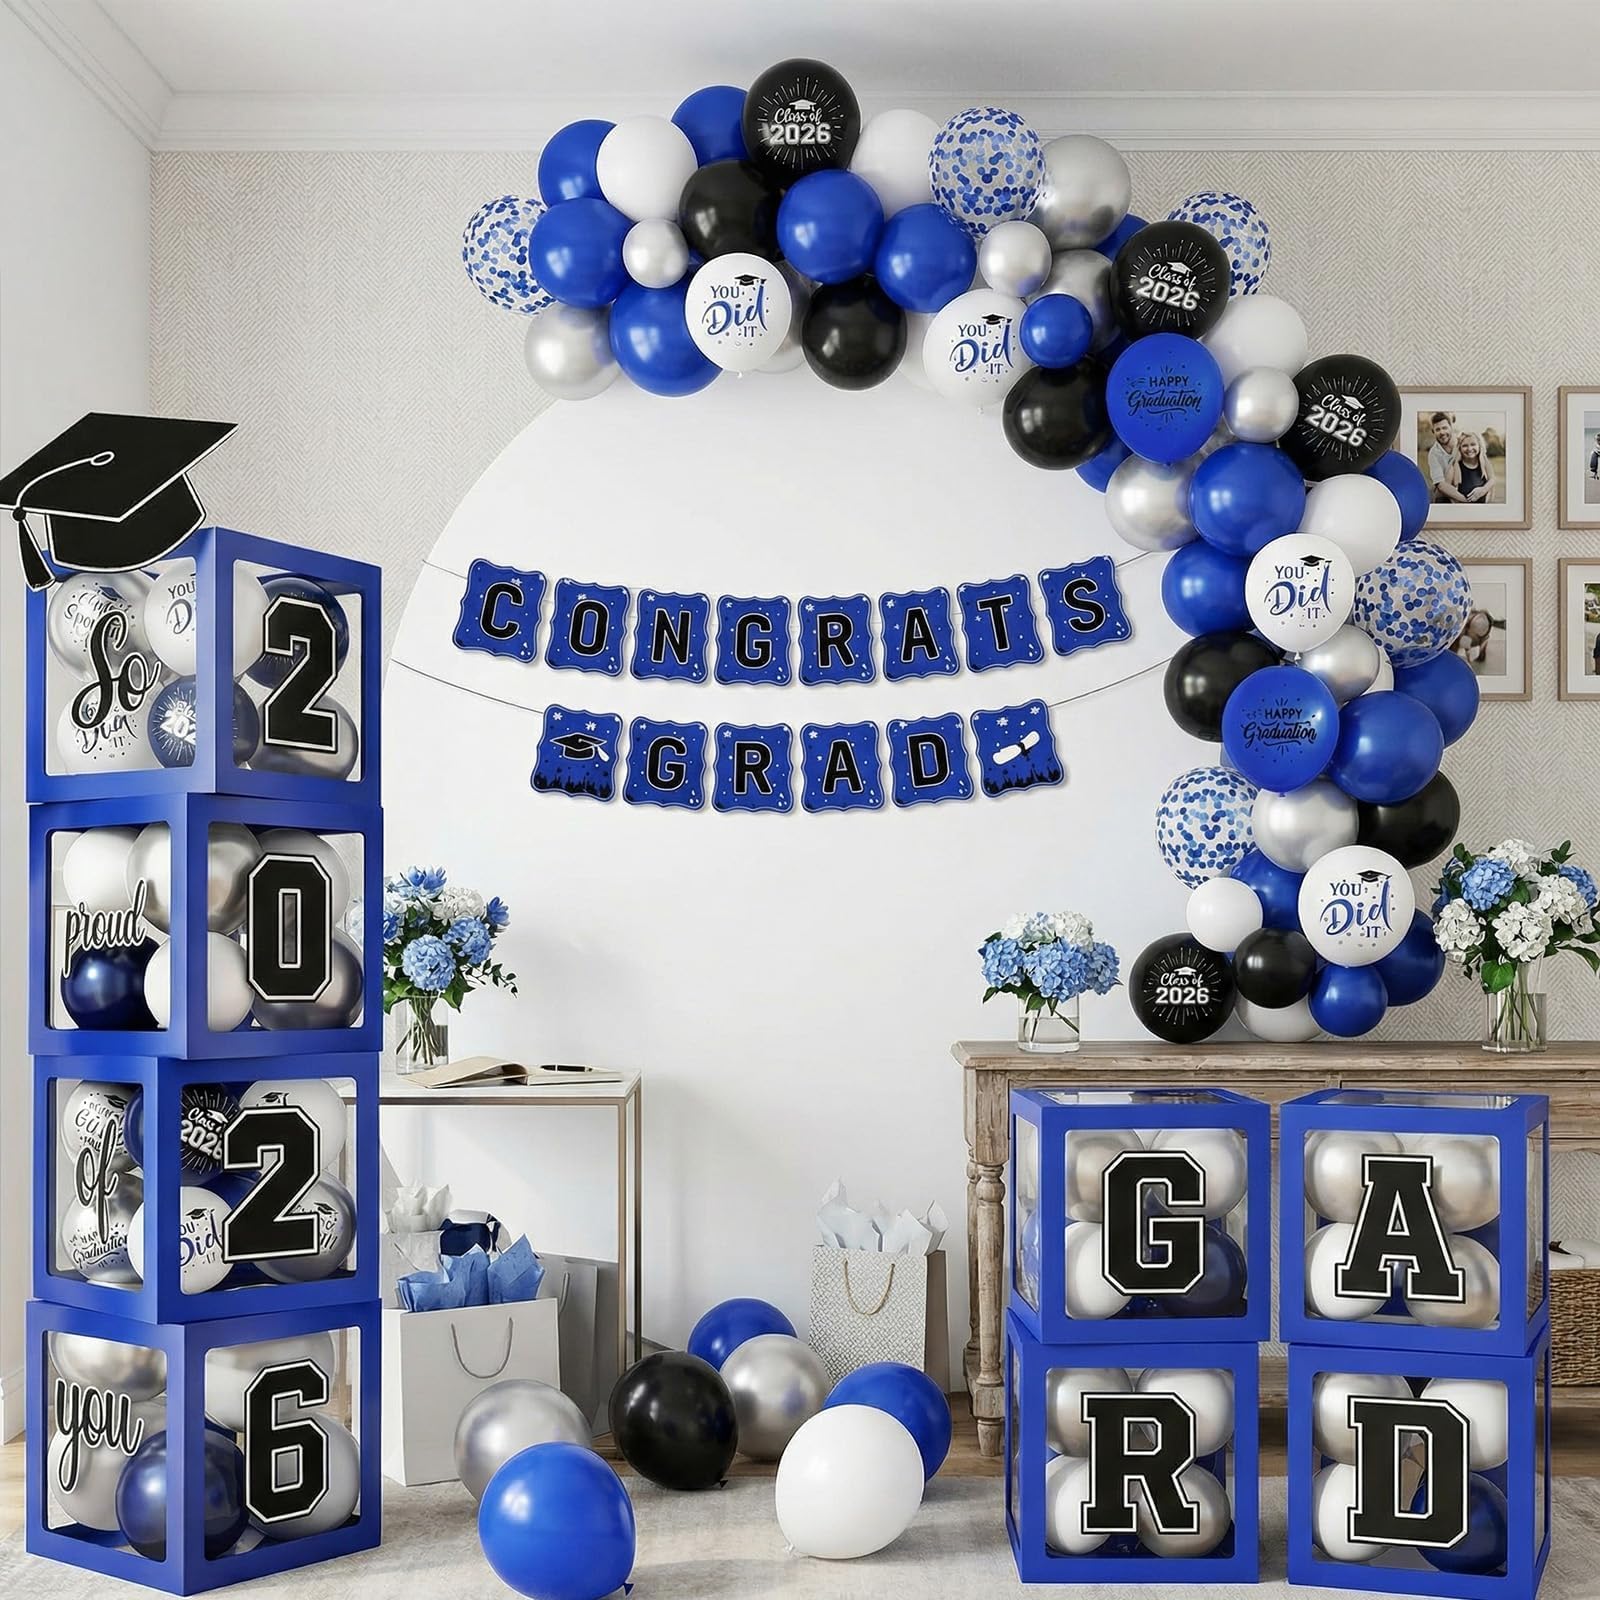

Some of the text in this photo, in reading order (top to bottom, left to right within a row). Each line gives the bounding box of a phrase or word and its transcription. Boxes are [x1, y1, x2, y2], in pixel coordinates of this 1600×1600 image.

[774, 107, 823, 125] Class of
[769, 122, 831, 145] 2026
[1148, 263, 1197, 292] Class of
[710, 285, 740, 299] YOU
[1136, 276, 1200, 311] 2026
[701, 284, 768, 336] Did
[743, 326, 758, 338] IT
[958, 323, 987, 338] YOU
[949, 324, 1014, 373] Did
[989, 362, 1004, 375] IT
[1149, 375, 1190, 388] HAPPY
[1127, 389, 1202, 417] Graduation
[1321, 393, 1367, 428] Class of
[1304, 404, 1368, 447] 2026
[1274, 565, 1305, 580] YOU
[1263, 563, 1332, 616] Did
[478, 576, 1106, 669] CONGRATS
[1307, 607, 1321, 619] IT
[71, 610, 162, 730] So
[1264, 707, 1303, 720] HAPPY
[1243, 721, 1317, 749] Graduation
[646, 732, 951, 796] GRAD
[1329, 882, 1362, 897] YOU
[1319, 879, 1394, 936] Did
[63, 877, 148, 979] proud
[1365, 925, 1382, 939] IT
[1160, 972, 1204, 988] Class of
[1155, 986, 1210, 1005] 2026
[74, 1113, 120, 1244] of
[55, 1377, 145, 1495] you
